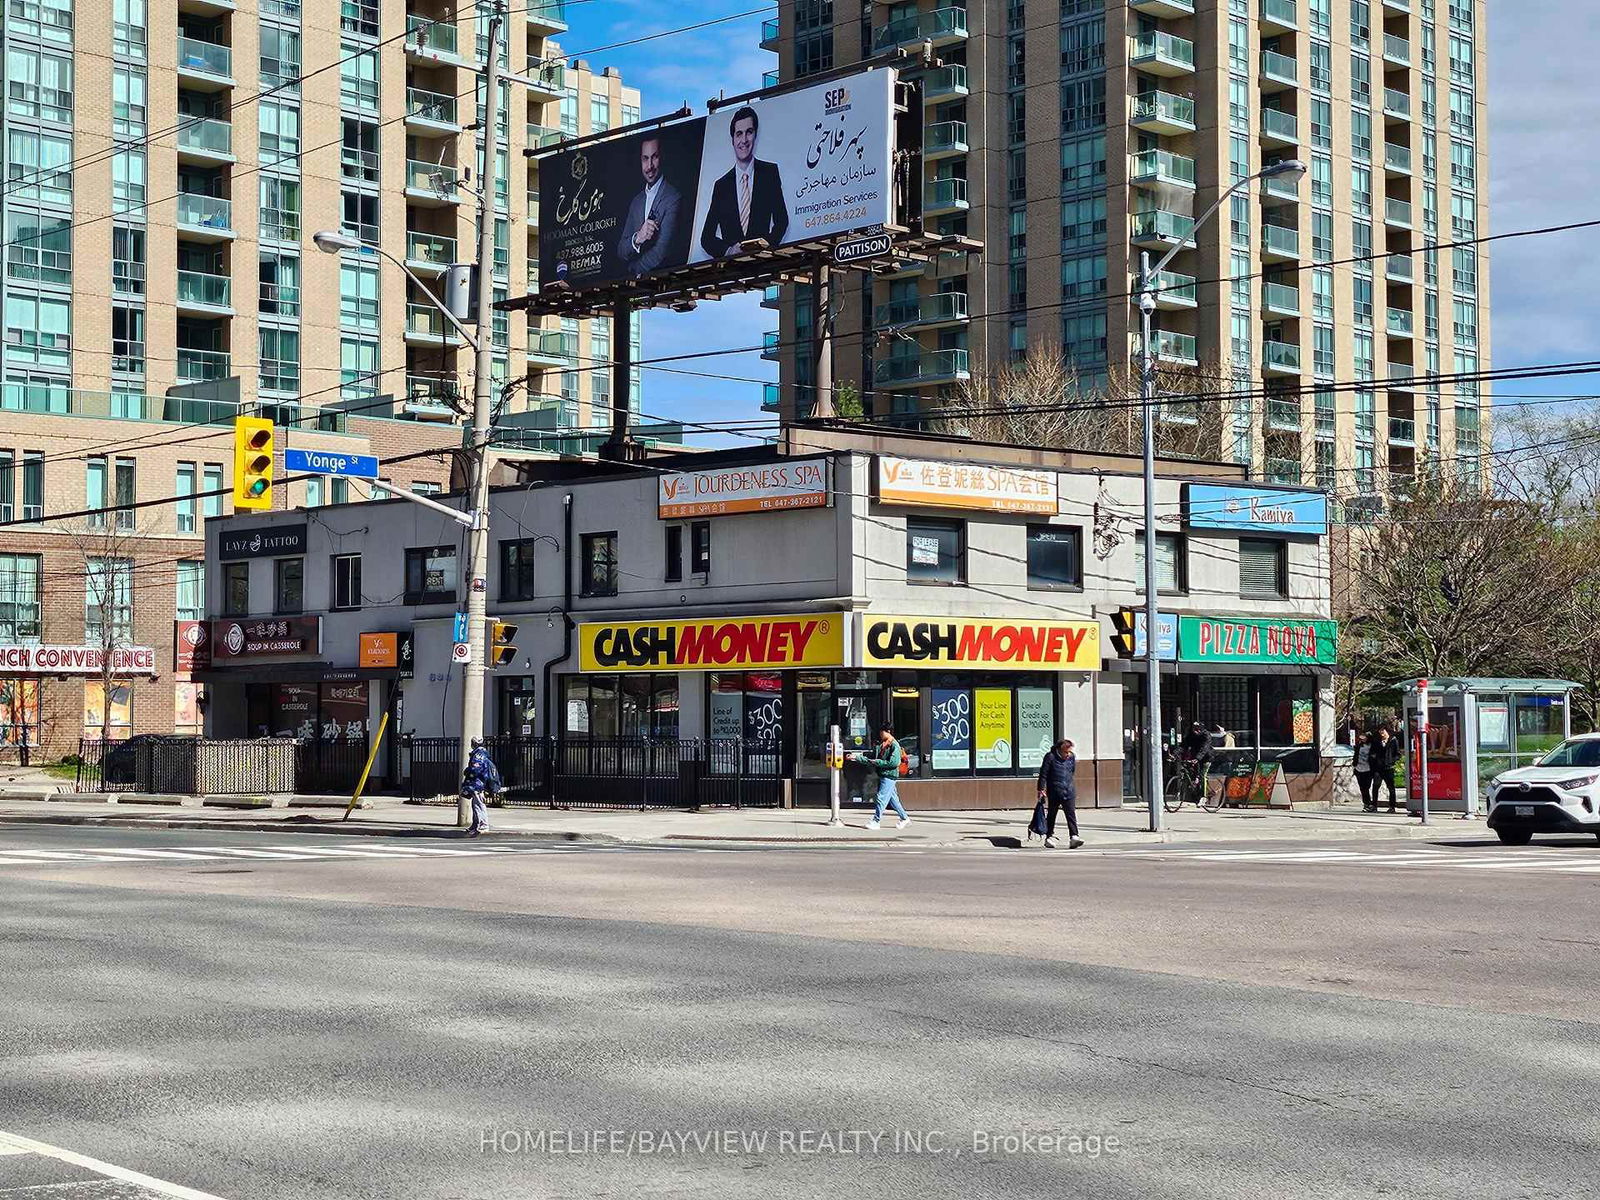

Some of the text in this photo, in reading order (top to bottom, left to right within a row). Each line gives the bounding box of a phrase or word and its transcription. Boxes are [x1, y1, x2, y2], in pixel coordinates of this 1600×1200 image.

[825, 87, 845, 109] SEP
[840, 164, 876, 186] سازمان
[795, 190, 878, 215] Immigration Services
[839, 238, 887, 258] PATTISON
[570, 254, 602, 270] RE/MAX
[304, 452, 359, 473] Yonge St
[694, 467, 789, 497] JOURDENESS
[796, 465, 822, 485] SPA
[760, 500, 772, 508] TEL
[1250, 496, 1295, 525] Kamiya
[264, 535, 299, 549] TATTOO
[247, 642, 262, 651] SOUP
[270, 640, 301, 650] CASSEROLE
[1200, 622, 1317, 657] PIZZA NOVA
[36, 649, 153, 668] CONVENENCE
[931, 693, 969, 725] $300
[980, 701, 993, 709] Your
[942, 718, 970, 746] $20
[979, 722, 1005, 730] Anytime
